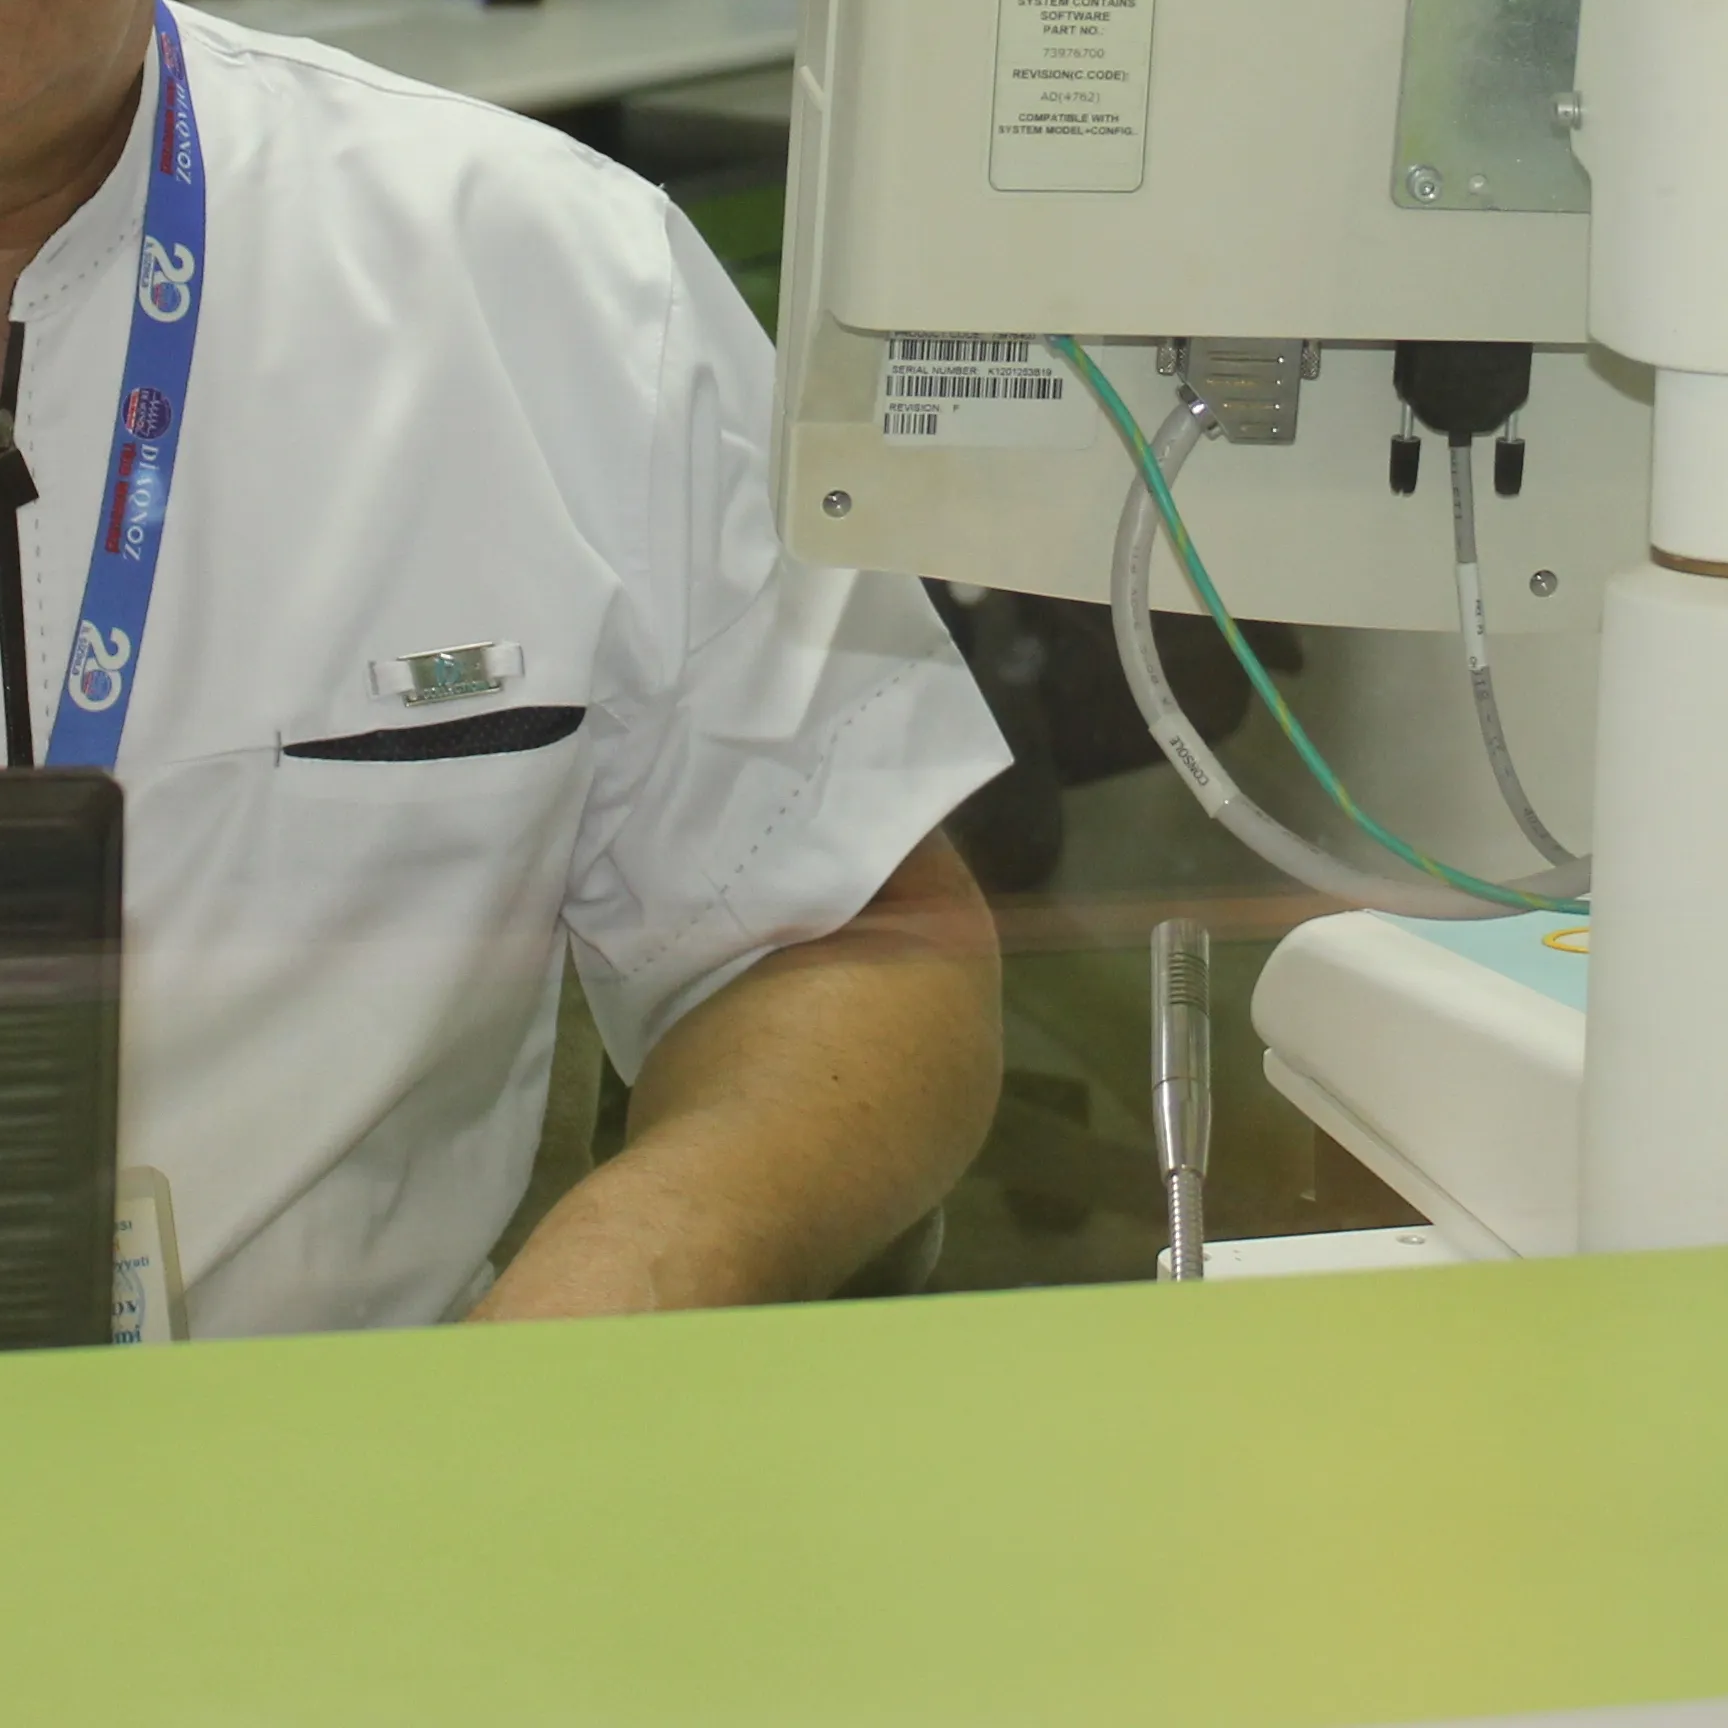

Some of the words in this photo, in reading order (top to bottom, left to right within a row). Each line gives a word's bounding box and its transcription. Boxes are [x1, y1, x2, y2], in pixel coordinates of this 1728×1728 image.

[1040, 11, 1111, 22] SOFTWARE
[1043, 24, 1076, 35] PART
[1018, 113, 1089, 123] COMPATIBLE
[1092, 114, 1120, 123] WITH
[998, 125, 1043, 135] SYSTEM
[138, 234, 196, 323] 20
[892, 365, 929, 375] SERIAL
[122, 443, 159, 562] DİAQNOZ
[67, 619, 132, 713] 20
[1169, 735, 1210, 788] CONSOLE
